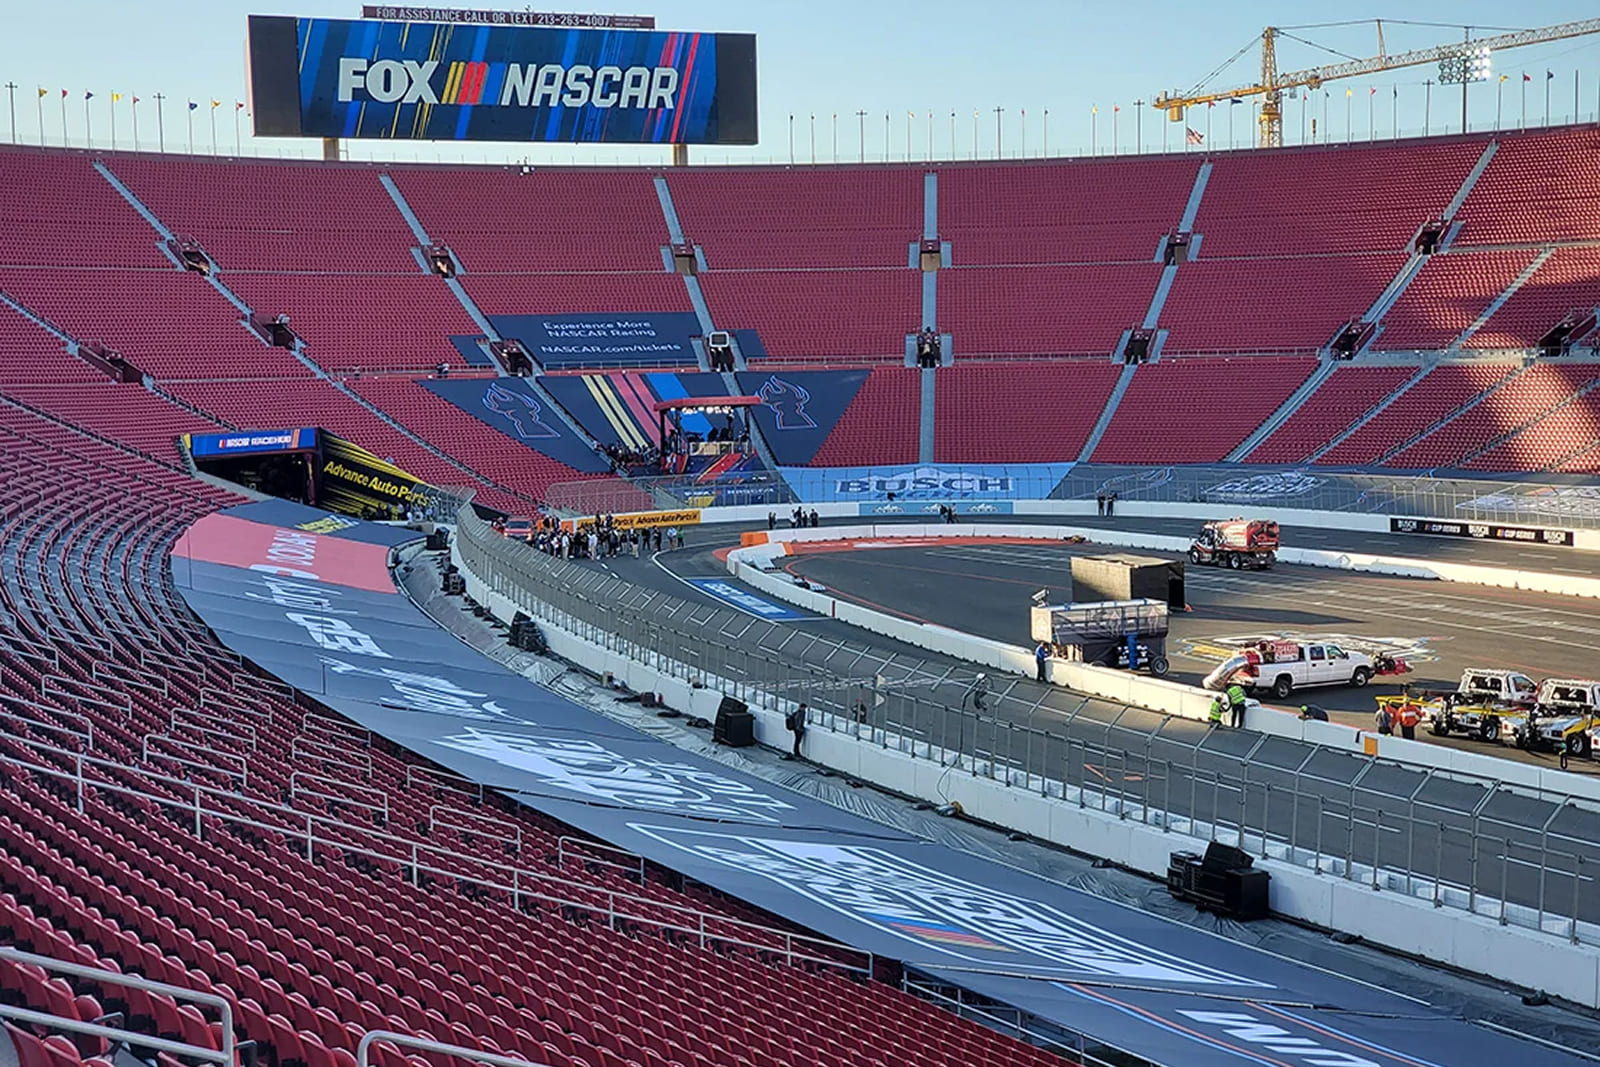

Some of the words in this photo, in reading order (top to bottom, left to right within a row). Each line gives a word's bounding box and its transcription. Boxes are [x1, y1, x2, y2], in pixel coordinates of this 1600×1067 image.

[376, 8, 397, 18] FOR
[399, 9, 461, 20] ASSISTANCE
[464, 11, 488, 22] CALL
[492, 13, 506, 23] OR
[509, 13, 535, 24] TEXT
[337, 57, 440, 104] FOX
[501, 63, 679, 109] NASCAR
[543, 322, 614, 331] Experience
[616, 320, 651, 329] More
[547, 329, 608, 338] NASCAR
[610, 329, 656, 338] Racing
[540, 344, 682, 354] NASCAR.com/tickets
[323, 461, 369, 487] Advance
[367, 476, 399, 497] Auto
[398, 485, 429, 507] Parts
[836, 477, 1014, 494] BUSCH
[1568, 688, 1578, 698] 2
[1531, 703, 1540, 714] 2
